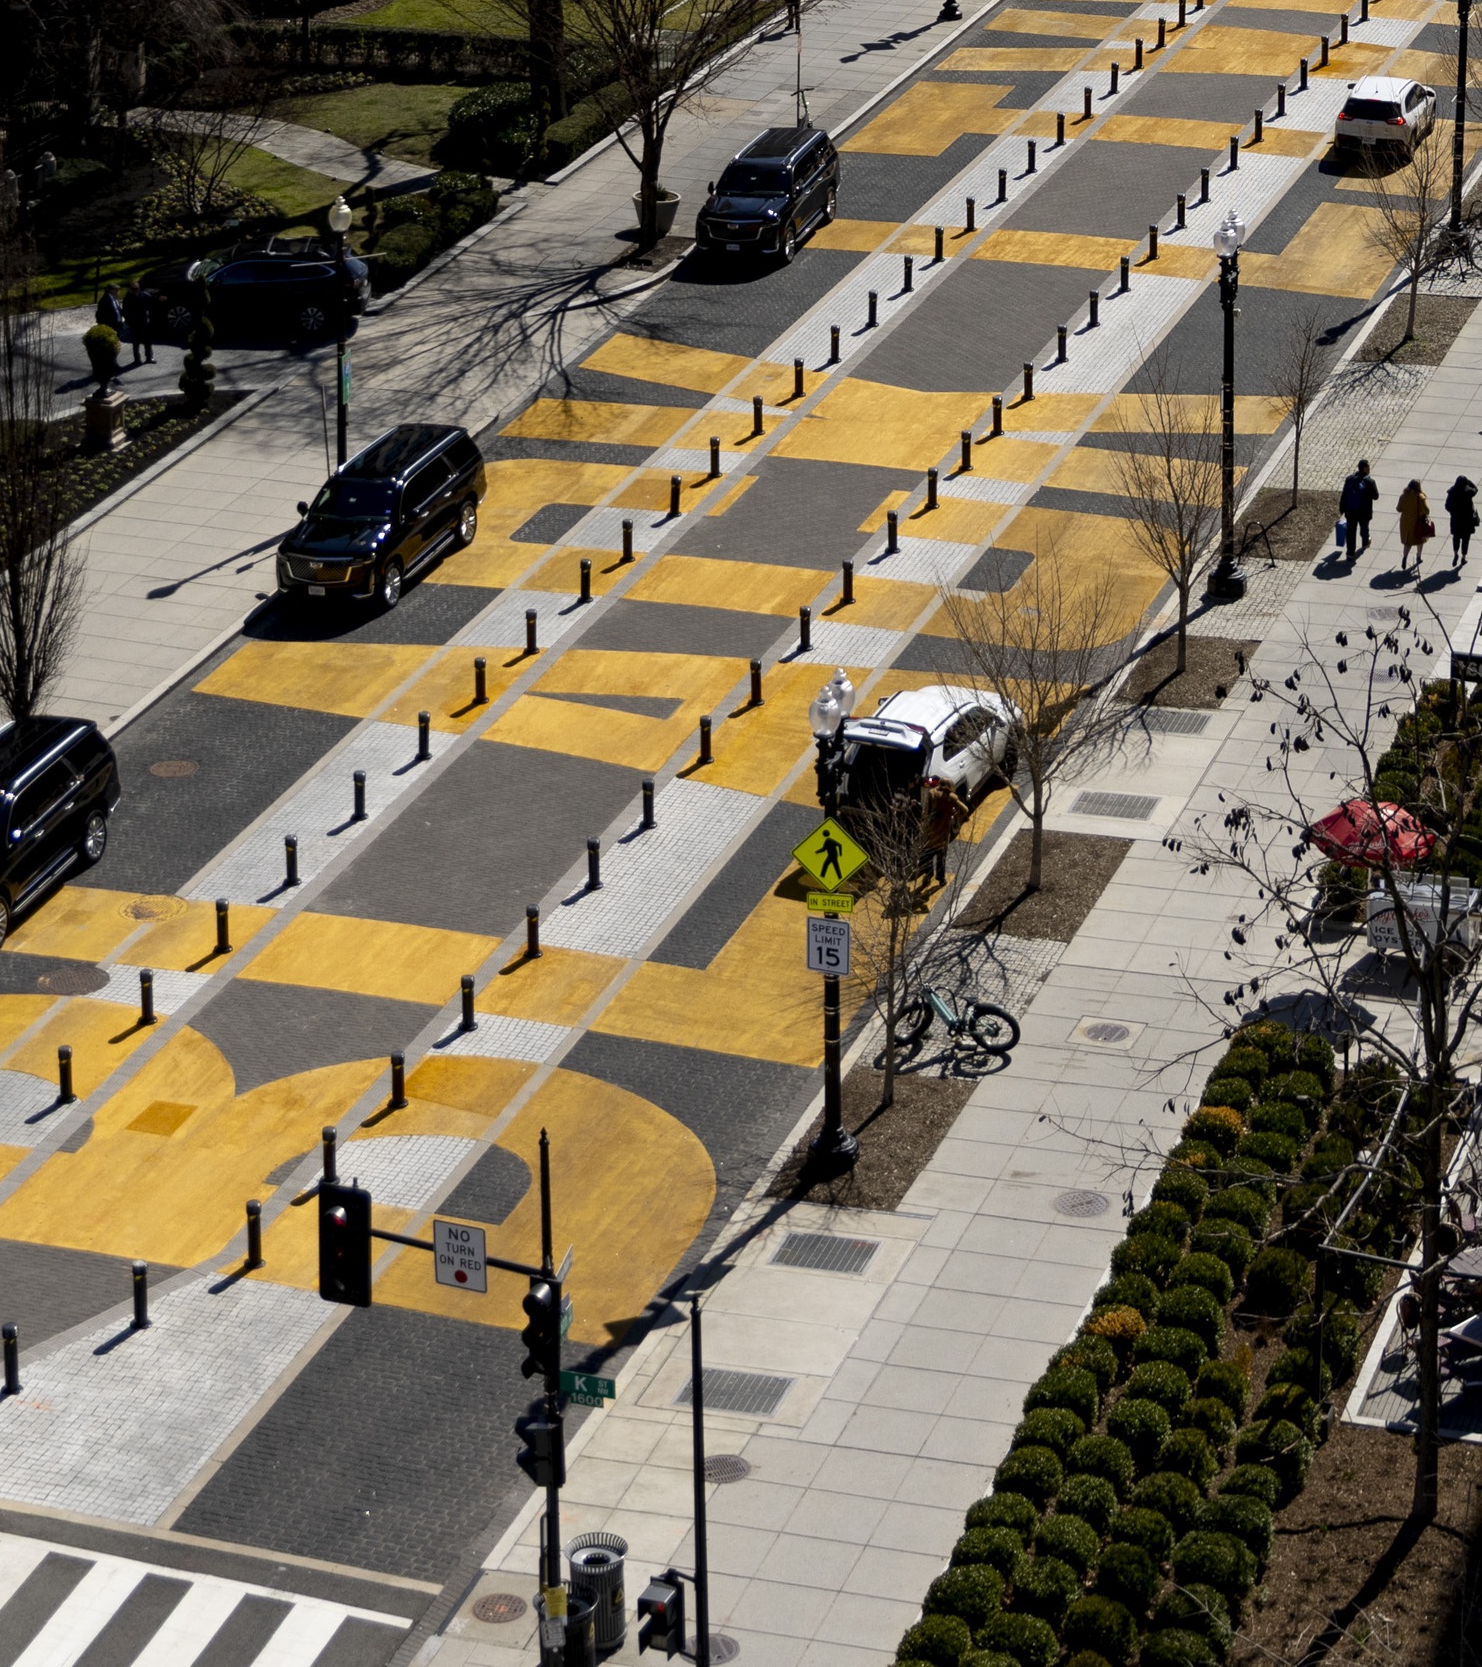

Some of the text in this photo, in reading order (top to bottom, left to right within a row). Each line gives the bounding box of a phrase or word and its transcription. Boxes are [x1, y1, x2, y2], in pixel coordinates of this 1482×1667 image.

[810, 898, 850, 908] IN STREET
[812, 923, 846, 936] SPEED
[1374, 926, 1394, 935] ICE
[815, 934, 842, 946] LIMIT
[816, 946, 840, 967] 15
[448, 1227, 470, 1242] NO
[445, 1242, 475, 1257] TURN
[439, 1254, 481, 1271] ON RED
[574, 1375, 608, 1392] K ST
[597, 1387, 609, 1396] NW
[571, 1392, 603, 1407] 1600
